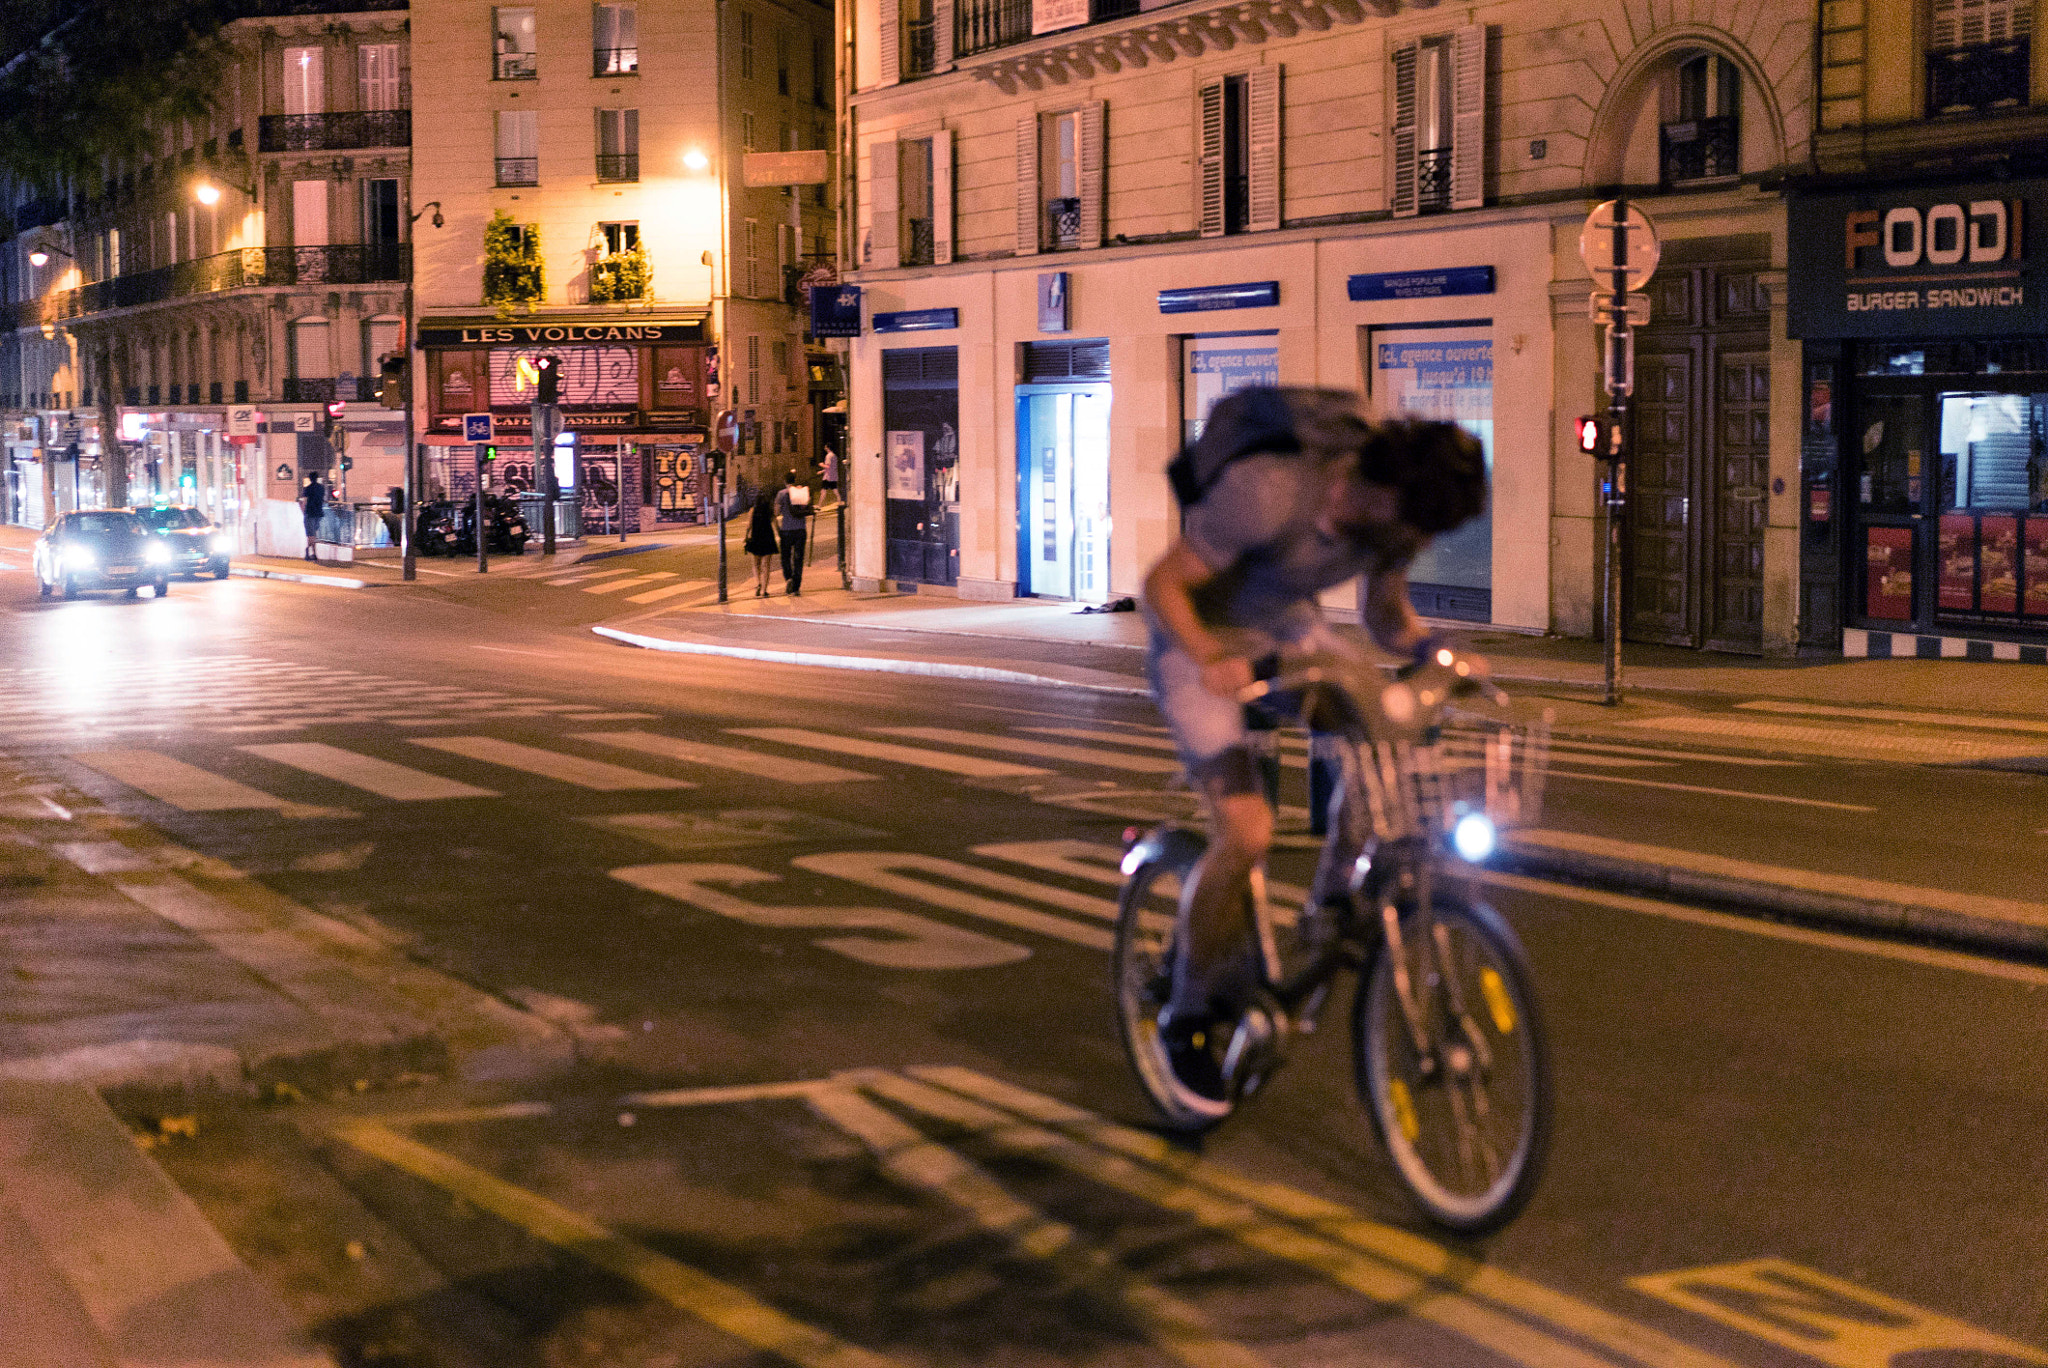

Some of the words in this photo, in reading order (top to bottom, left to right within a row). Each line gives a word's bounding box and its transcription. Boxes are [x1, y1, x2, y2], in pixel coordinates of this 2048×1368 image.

[1846, 200, 2008, 269] FOOD
[1847, 291, 1920, 311] BURGER
[1927, 287, 2024, 308] SANDWICH
[461, 329, 514, 343] LES
[525, 326, 663, 342] VOLCANS
[1208, 355, 1243, 373] agence
[1400, 348, 1443, 369] agence
